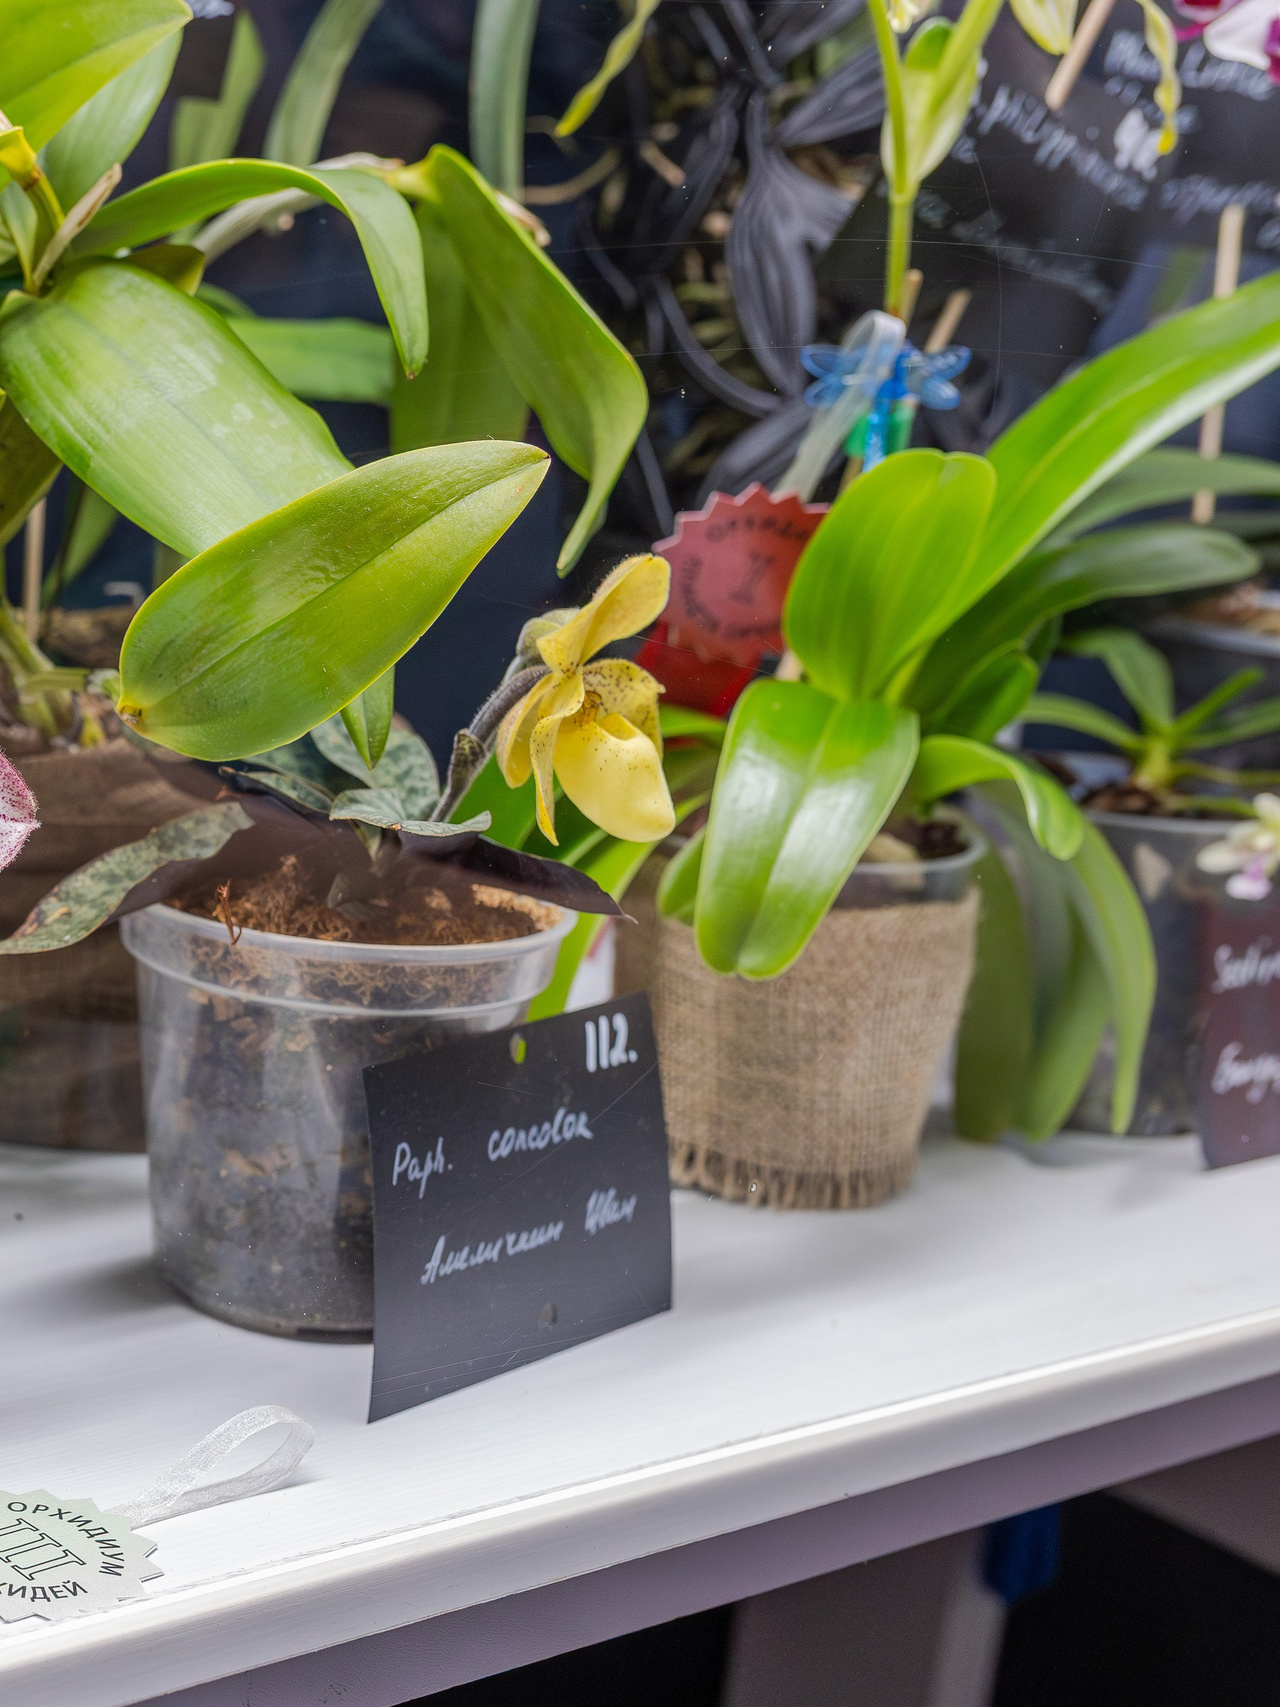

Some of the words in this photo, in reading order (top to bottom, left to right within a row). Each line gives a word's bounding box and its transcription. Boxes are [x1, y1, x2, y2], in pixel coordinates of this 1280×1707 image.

[585, 1012, 638, 1073] 112.
[393, 1136, 453, 1199] Paph.
[7, 1501, 124, 1577] ОРХИДИУМ
